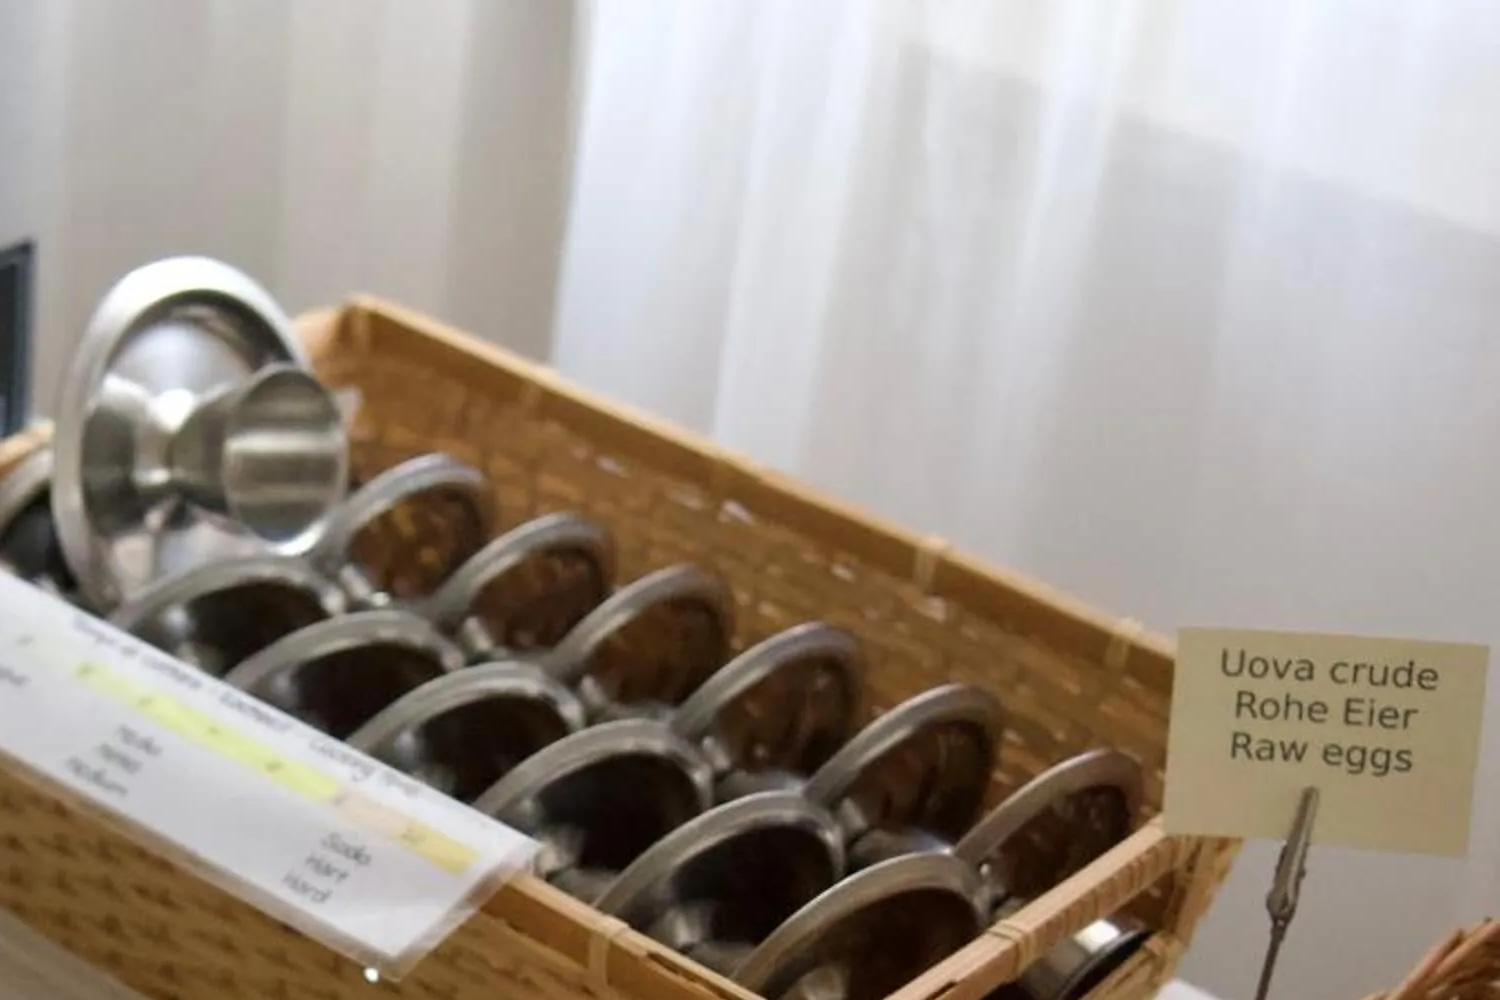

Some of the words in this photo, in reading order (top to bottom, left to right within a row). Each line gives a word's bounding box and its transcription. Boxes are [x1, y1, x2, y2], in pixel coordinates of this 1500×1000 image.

[1220, 647, 1315, 681] Uova
[1329, 660, 1440, 692] crude
[1235, 690, 1329, 724] Rohe
[1343, 697, 1419, 730] Eier
[1230, 731, 1308, 763] Raw
[1321, 743, 1414, 778] eggs
